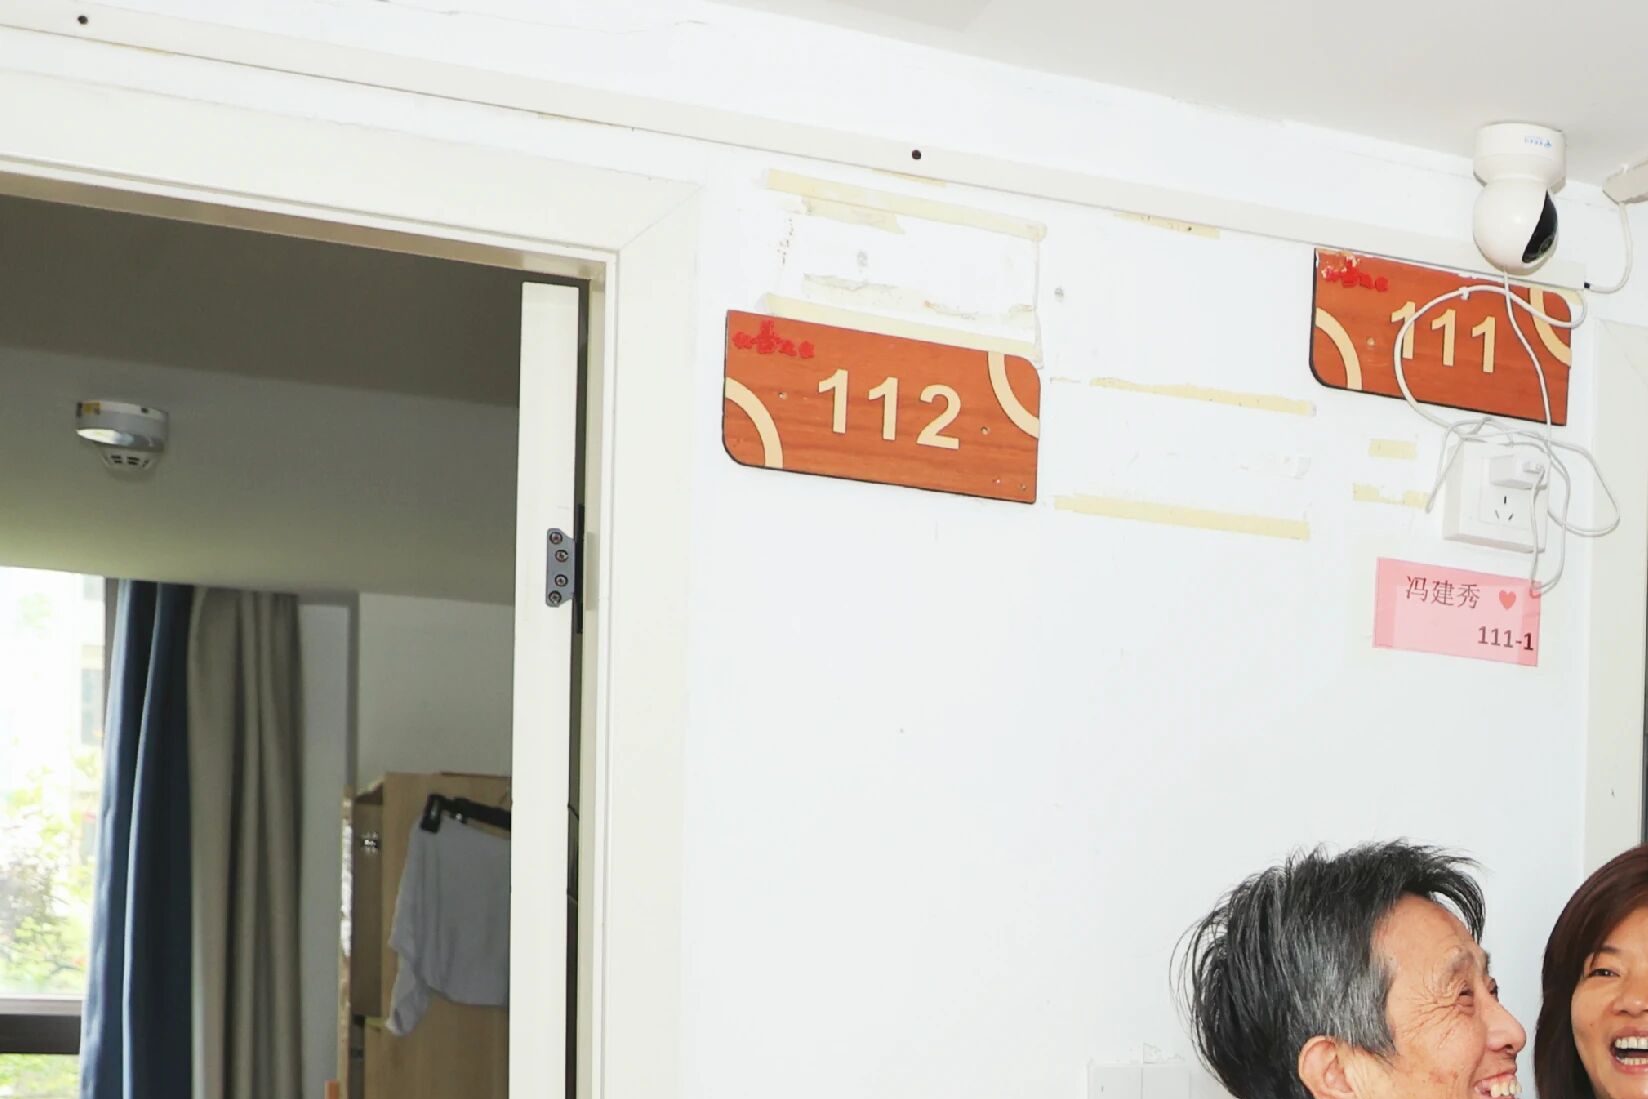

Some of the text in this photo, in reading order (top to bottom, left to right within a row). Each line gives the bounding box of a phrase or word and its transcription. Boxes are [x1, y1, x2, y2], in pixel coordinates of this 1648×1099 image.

[1390, 300, 1496, 373] 111
[817, 368, 962, 450] 112
[1405, 575, 1481, 609] 冯建秀
[1477, 625, 1534, 651] 111-1
